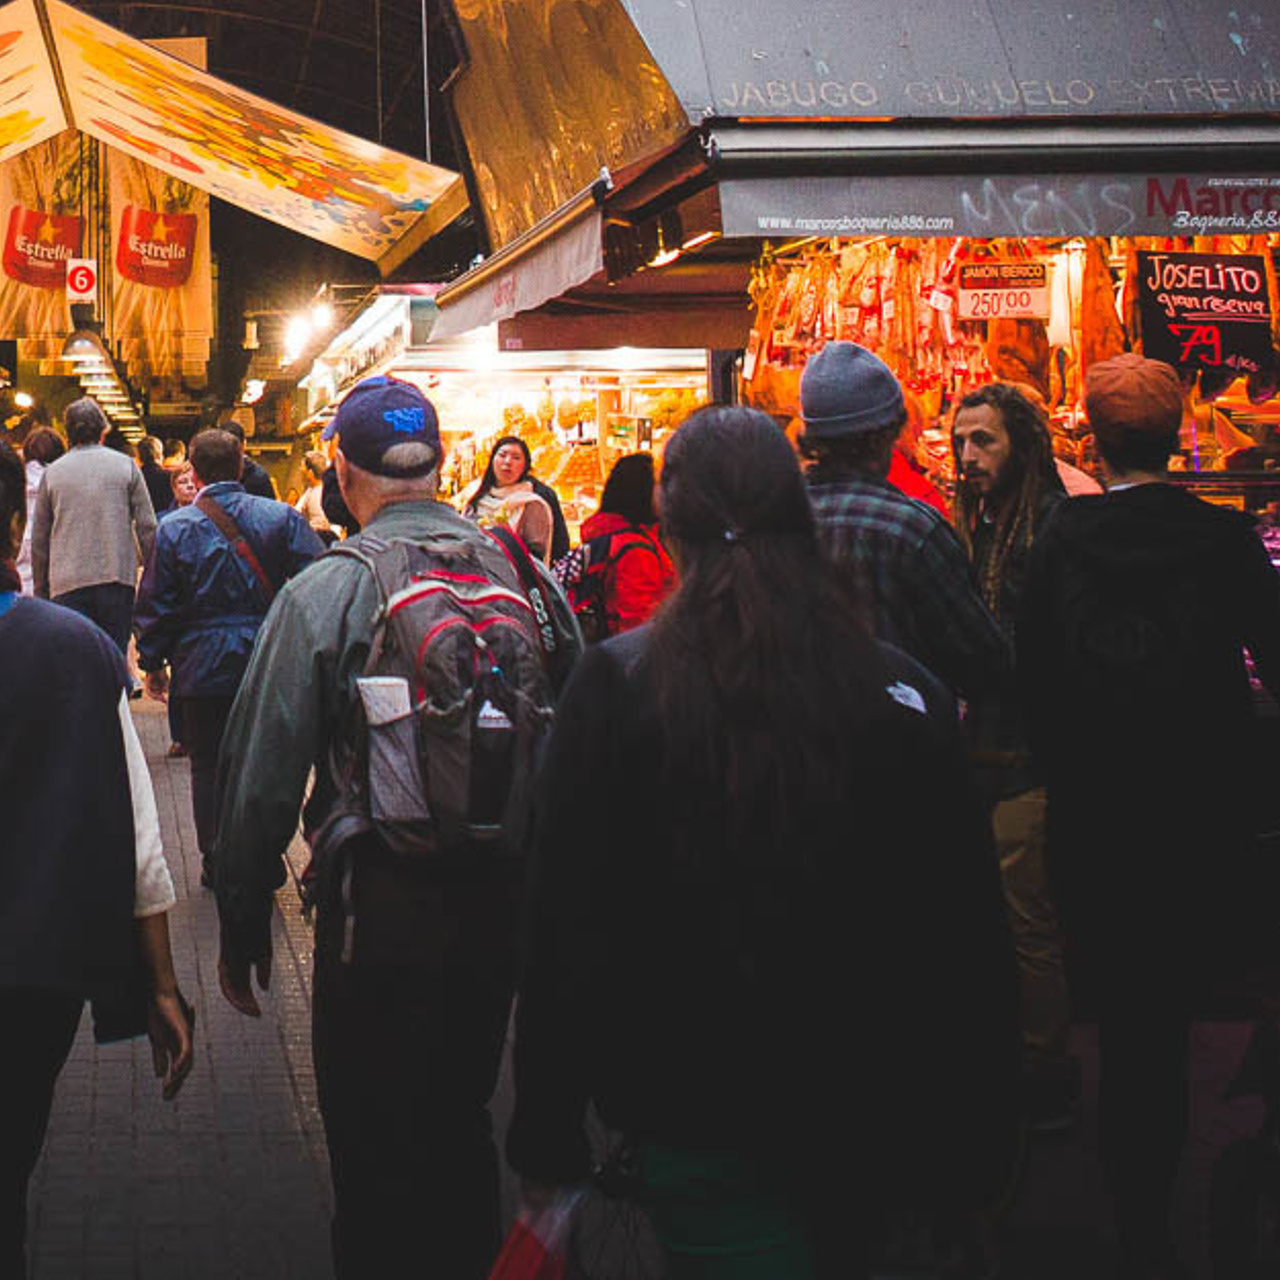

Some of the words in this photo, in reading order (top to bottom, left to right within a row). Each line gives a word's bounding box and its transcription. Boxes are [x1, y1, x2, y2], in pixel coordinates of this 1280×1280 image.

[721, 79, 878, 109] JABUGO
[16, 234, 74, 262] Estrella
[129, 233, 187, 260] Estrella
[74, 270, 89, 291] 6
[1157, 293, 1200, 318] gran
[1202, 295, 1266, 316] reserva
[1166, 323, 1223, 367] 79
